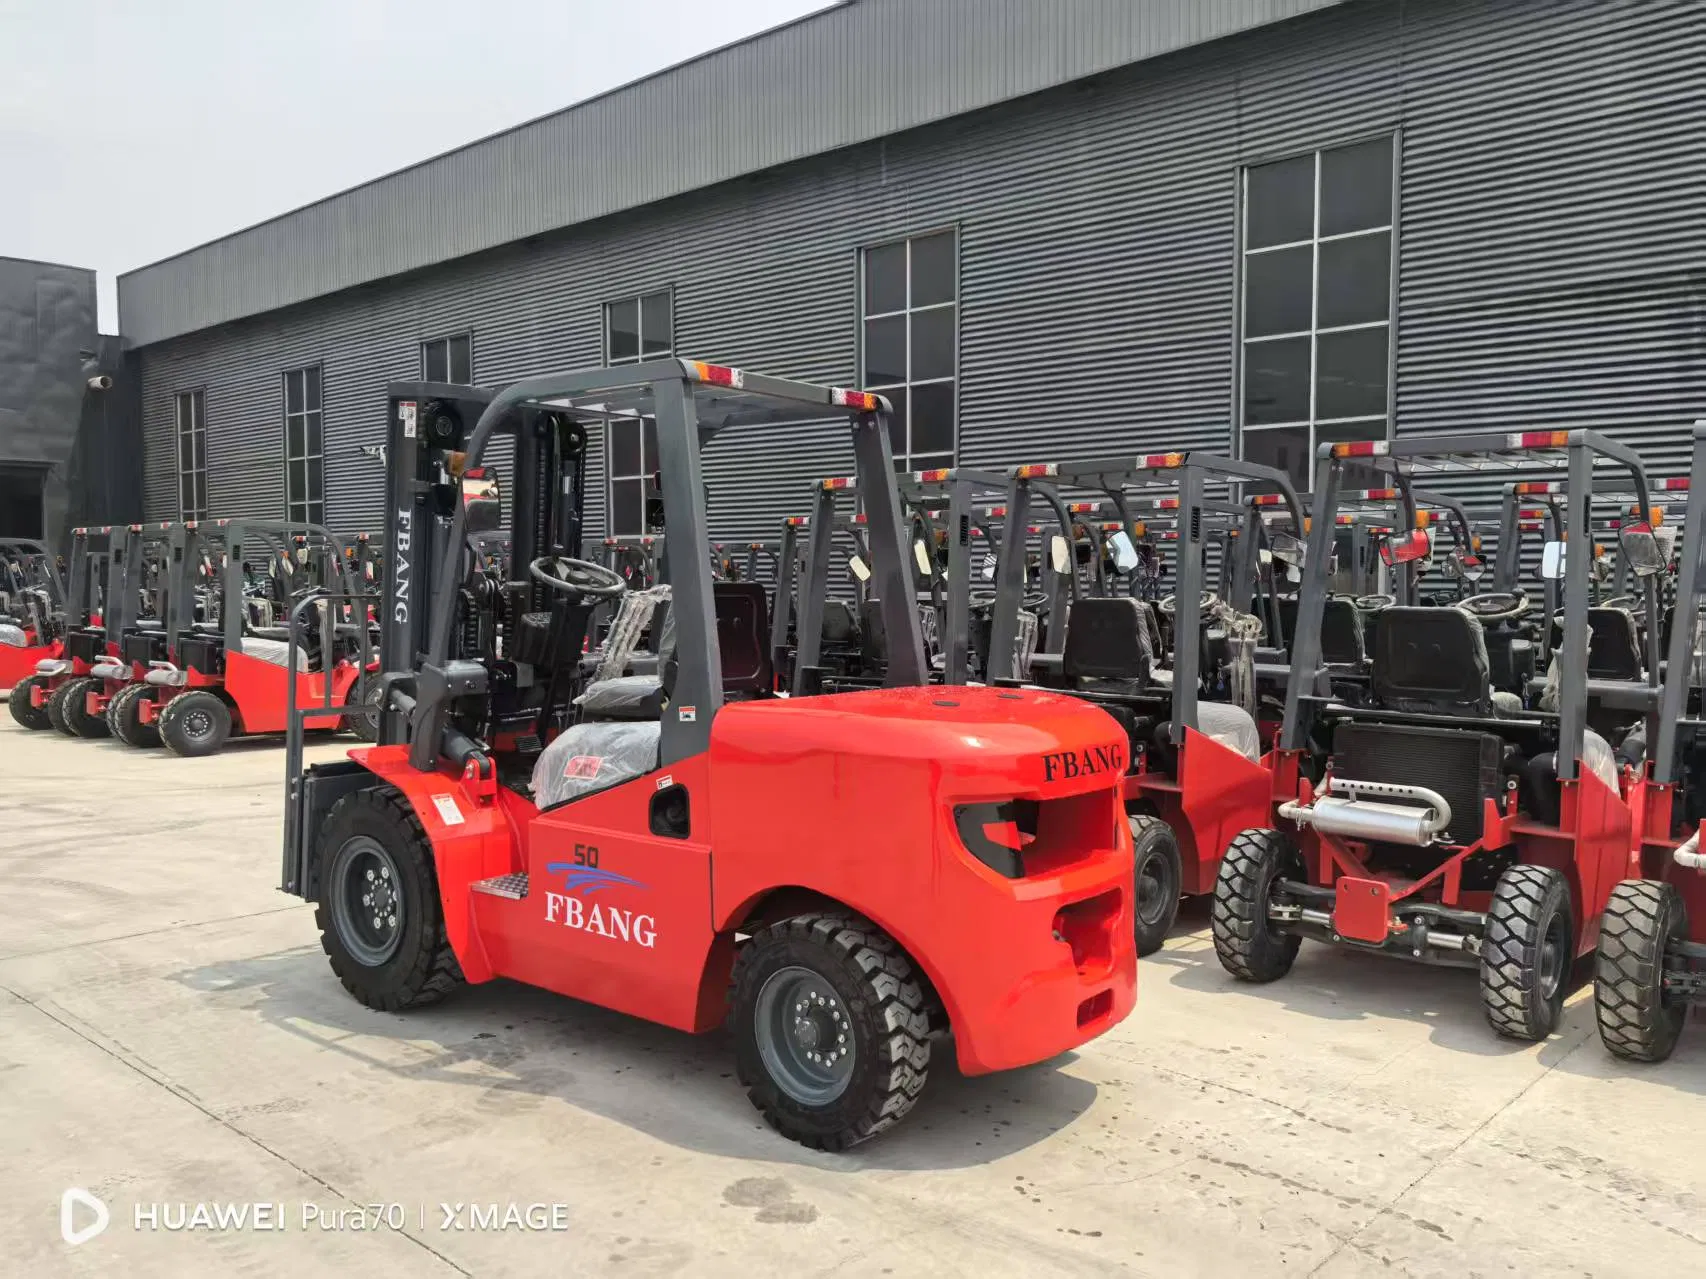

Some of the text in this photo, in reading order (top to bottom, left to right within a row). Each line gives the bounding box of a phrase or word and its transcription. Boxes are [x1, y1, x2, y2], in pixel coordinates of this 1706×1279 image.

[395, 507, 412, 625] FBANG
[1041, 744, 1122, 783] FBANG
[574, 843, 599, 869] 50
[544, 891, 657, 948] FBANG
